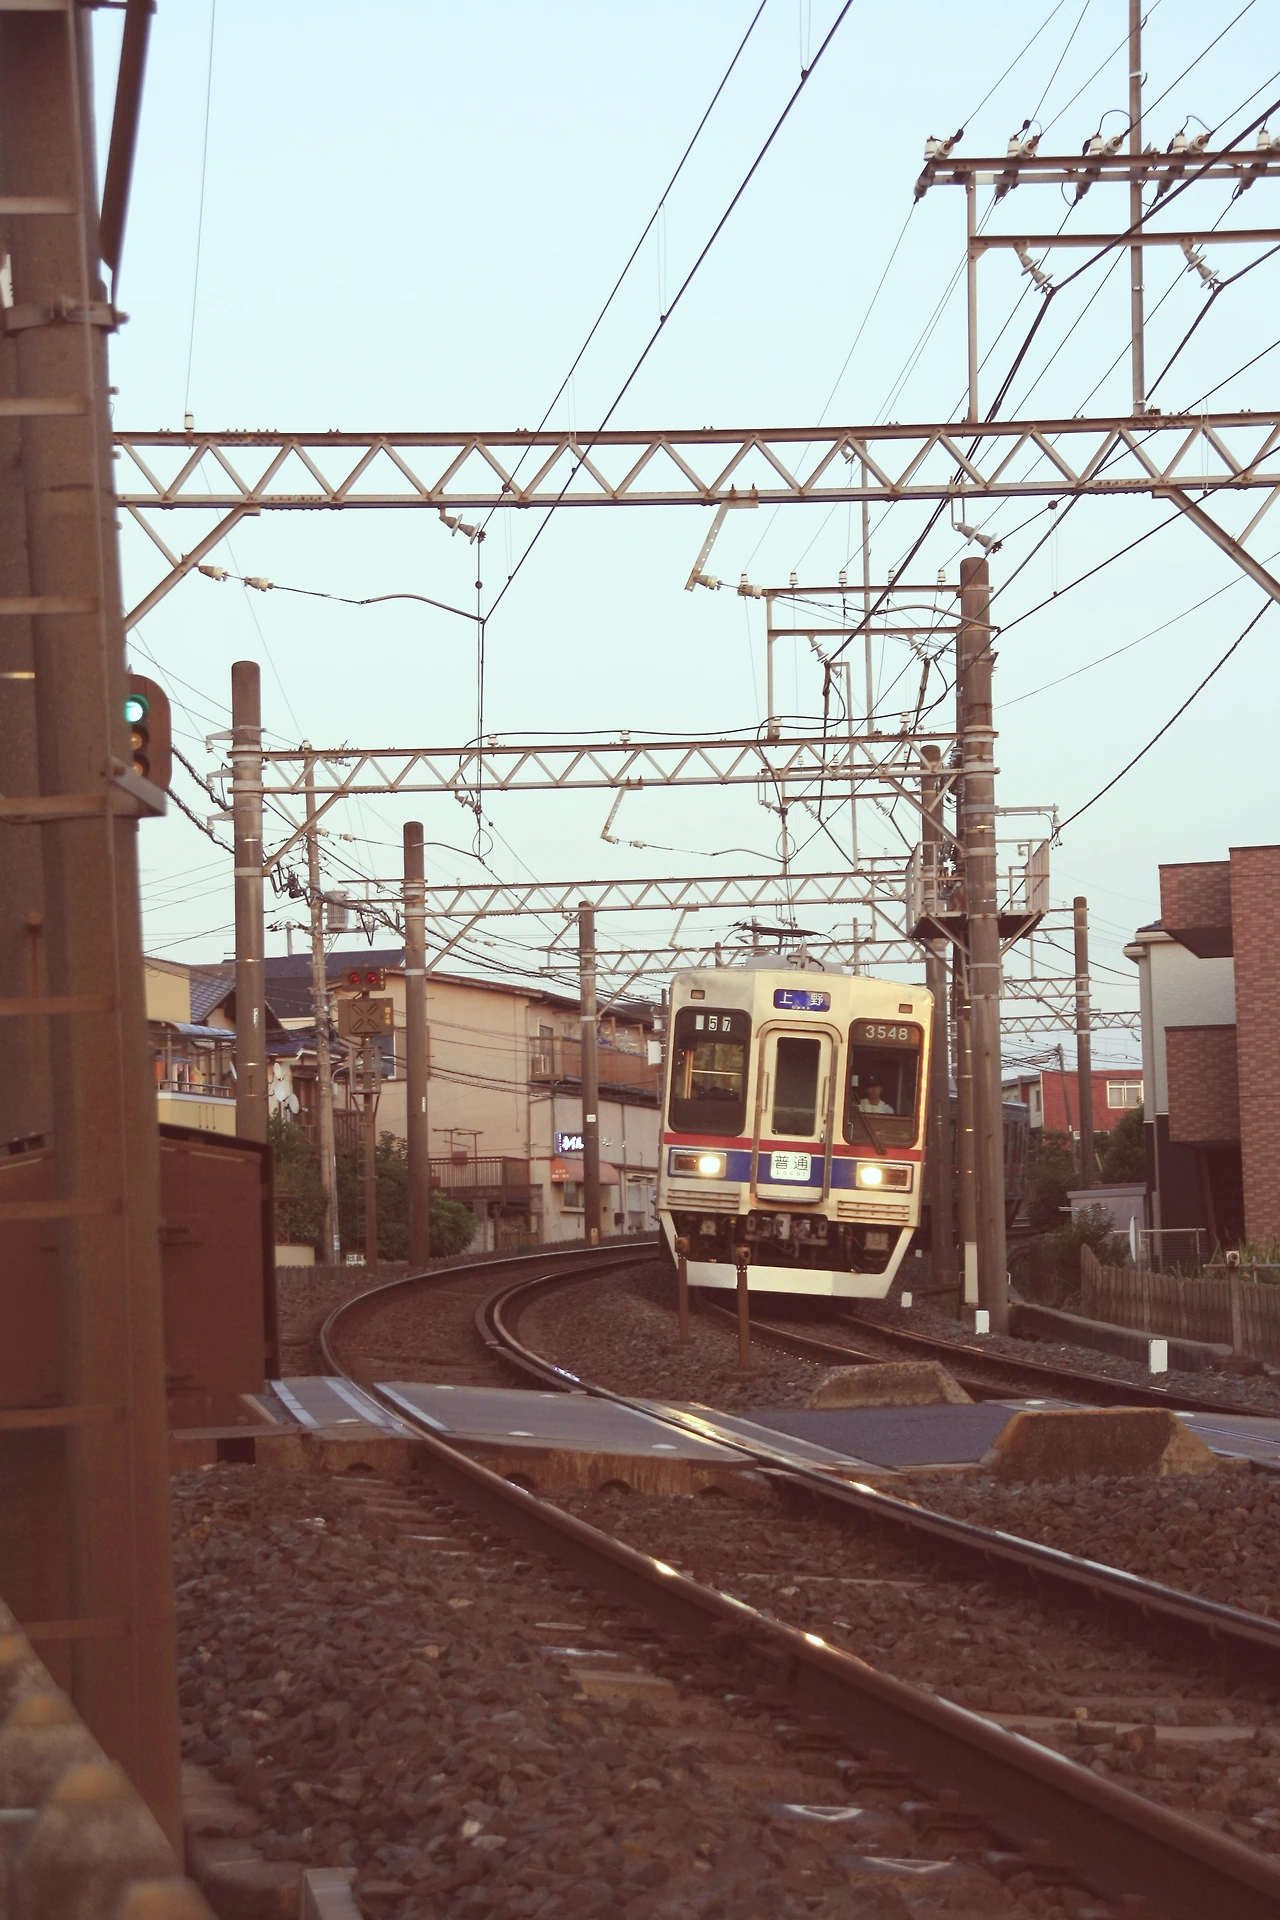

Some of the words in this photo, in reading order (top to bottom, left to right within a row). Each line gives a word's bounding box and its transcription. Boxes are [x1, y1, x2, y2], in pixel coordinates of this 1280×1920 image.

[779, 991, 824, 1006] 上野
[709, 1018, 731, 1031] 57
[865, 1025, 908, 1040] 3548
[562, 1135, 585, 1151] ネイル
[774, 1154, 808, 1171] 普通
